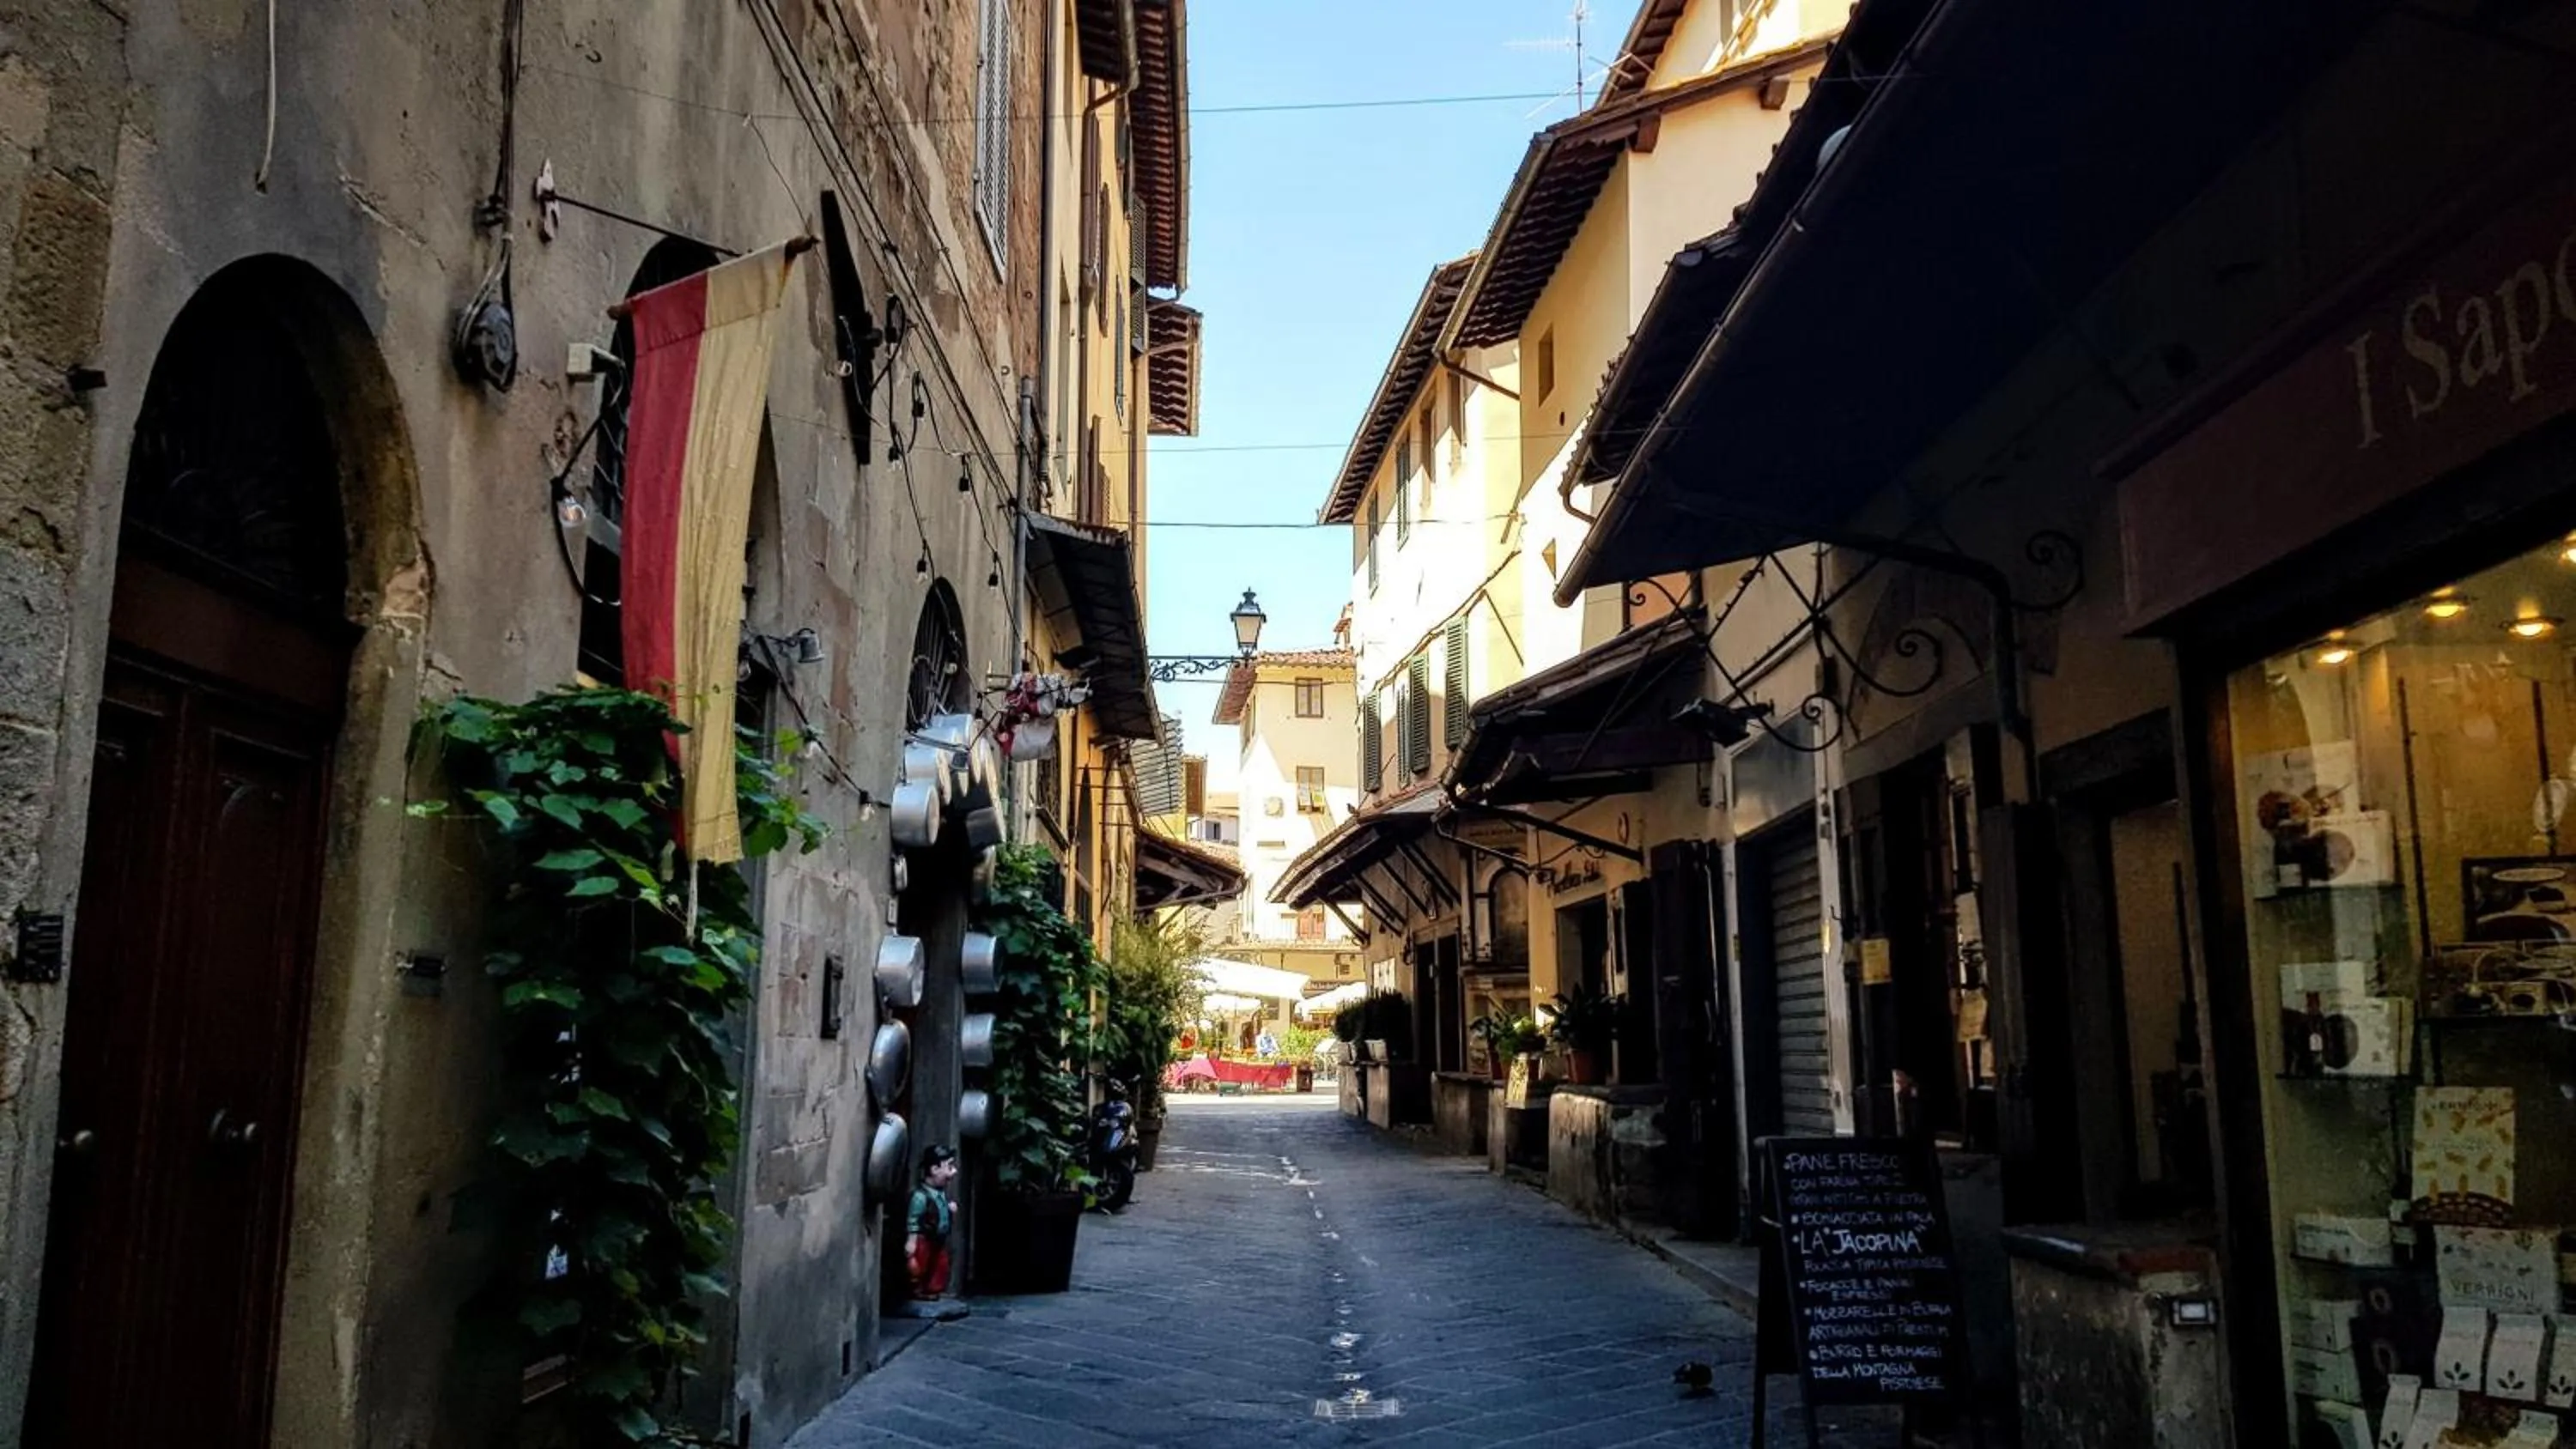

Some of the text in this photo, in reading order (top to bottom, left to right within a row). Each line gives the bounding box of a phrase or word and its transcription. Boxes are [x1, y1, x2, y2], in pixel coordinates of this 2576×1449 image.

[2344, 330, 2384, 449] I
[1786, 1151, 1899, 1172] PANE FRESCO
[1801, 1228, 1830, 1258] LA
[1810, 1366, 1851, 1379] DELLA
